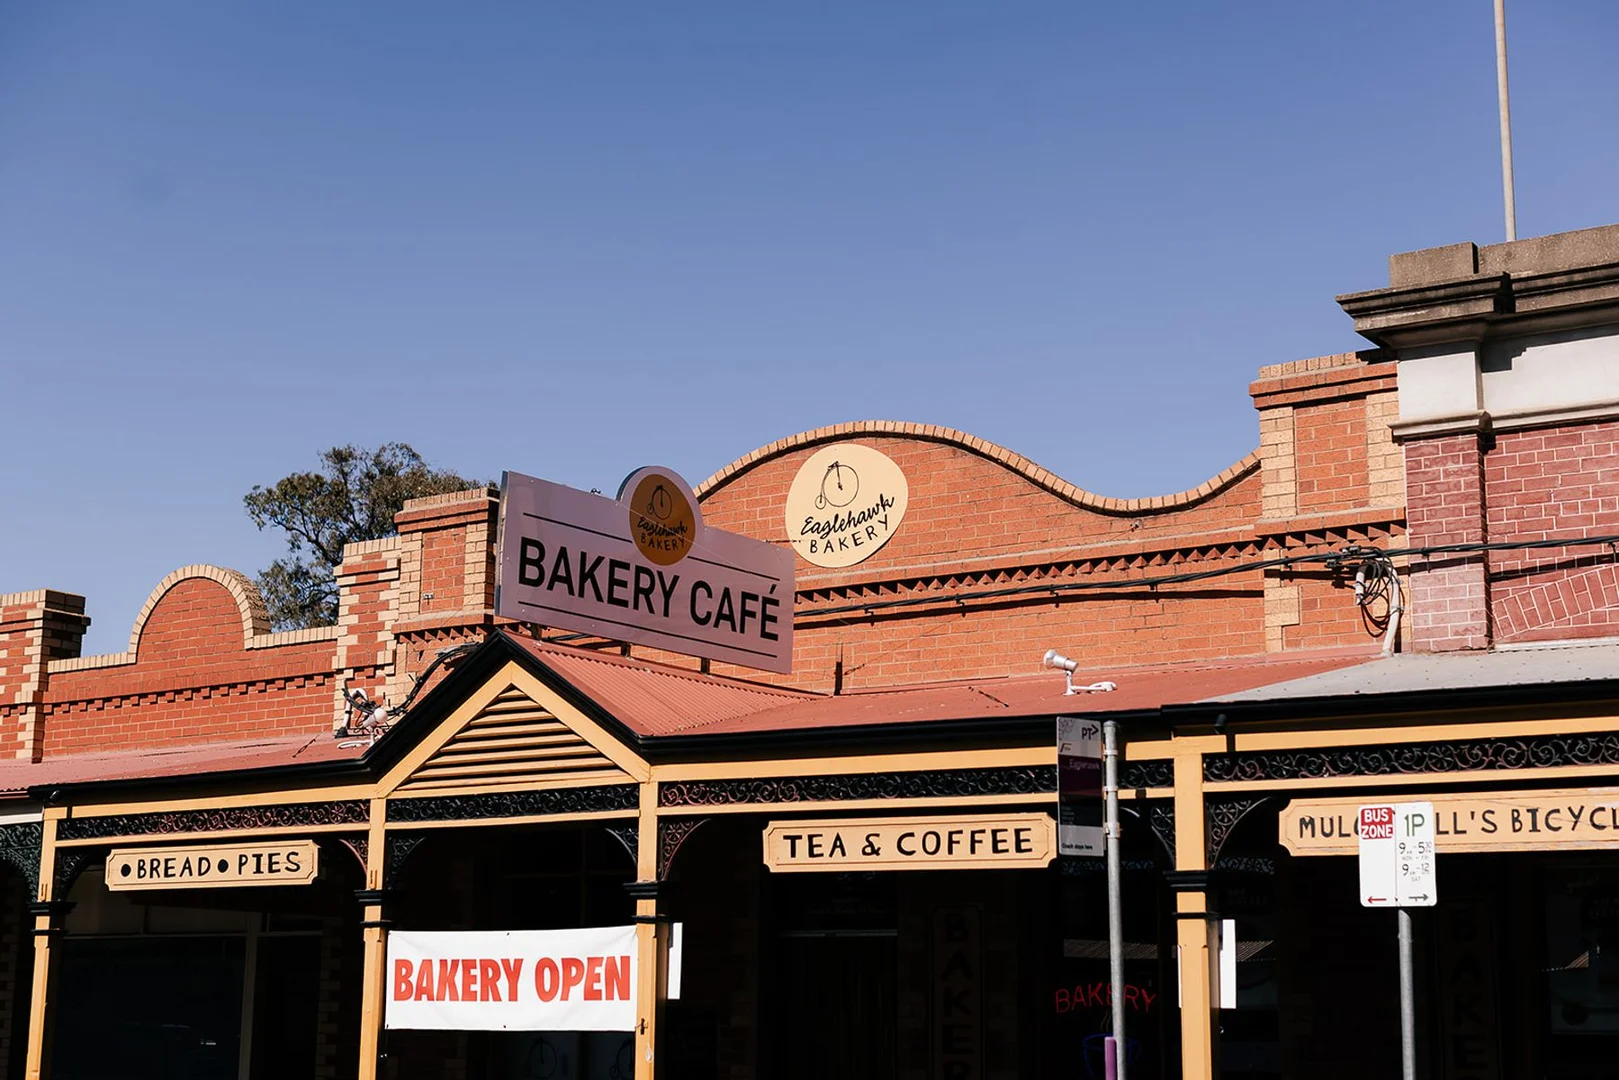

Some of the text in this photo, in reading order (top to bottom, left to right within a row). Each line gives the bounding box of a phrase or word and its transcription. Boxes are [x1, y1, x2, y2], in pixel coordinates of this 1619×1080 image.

[637, 516, 688, 537] Eaglehawk
[801, 493, 895, 540] Eaglehawk
[641, 532, 685, 551] BAKERY
[809, 513, 888, 554] BAKERY
[518, 535, 780, 642] BAKERY CAFÉ
[1363, 809, 1389, 823] BUS
[1404, 813, 1425, 837] 1P
[783, 827, 1034, 859] TEA & COFFEE
[1361, 824, 1394, 838] ZONE
[136, 851, 301, 879] BREAD PIES
[393, 955, 631, 1002] BAKERY OPEN
